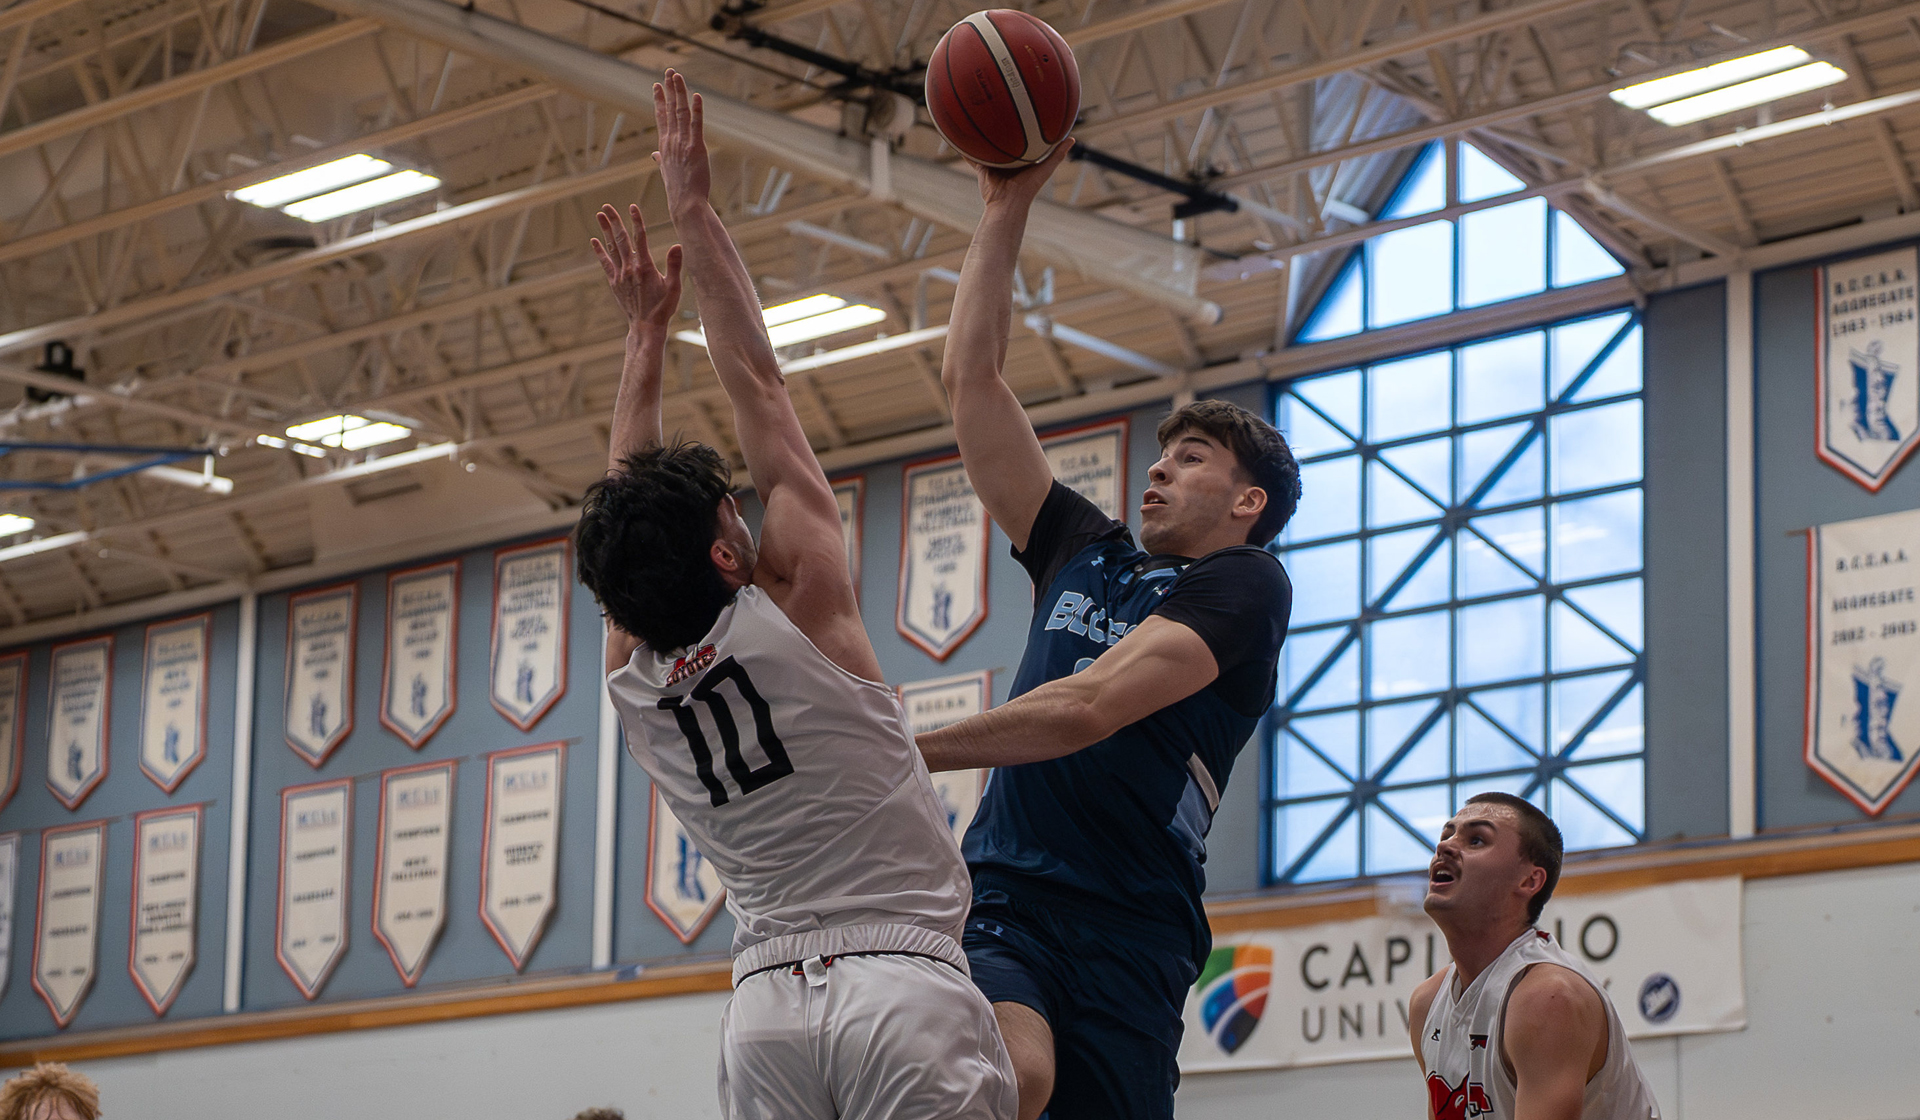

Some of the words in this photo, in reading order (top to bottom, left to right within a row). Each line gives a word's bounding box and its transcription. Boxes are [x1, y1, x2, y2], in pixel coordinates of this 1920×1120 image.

[1833, 286, 1914, 315] AGGREGATE
[1832, 587, 1914, 612] AGGREGATE
[657, 655, 795, 808] 10
[1301, 914, 1619, 992] CAPIO
